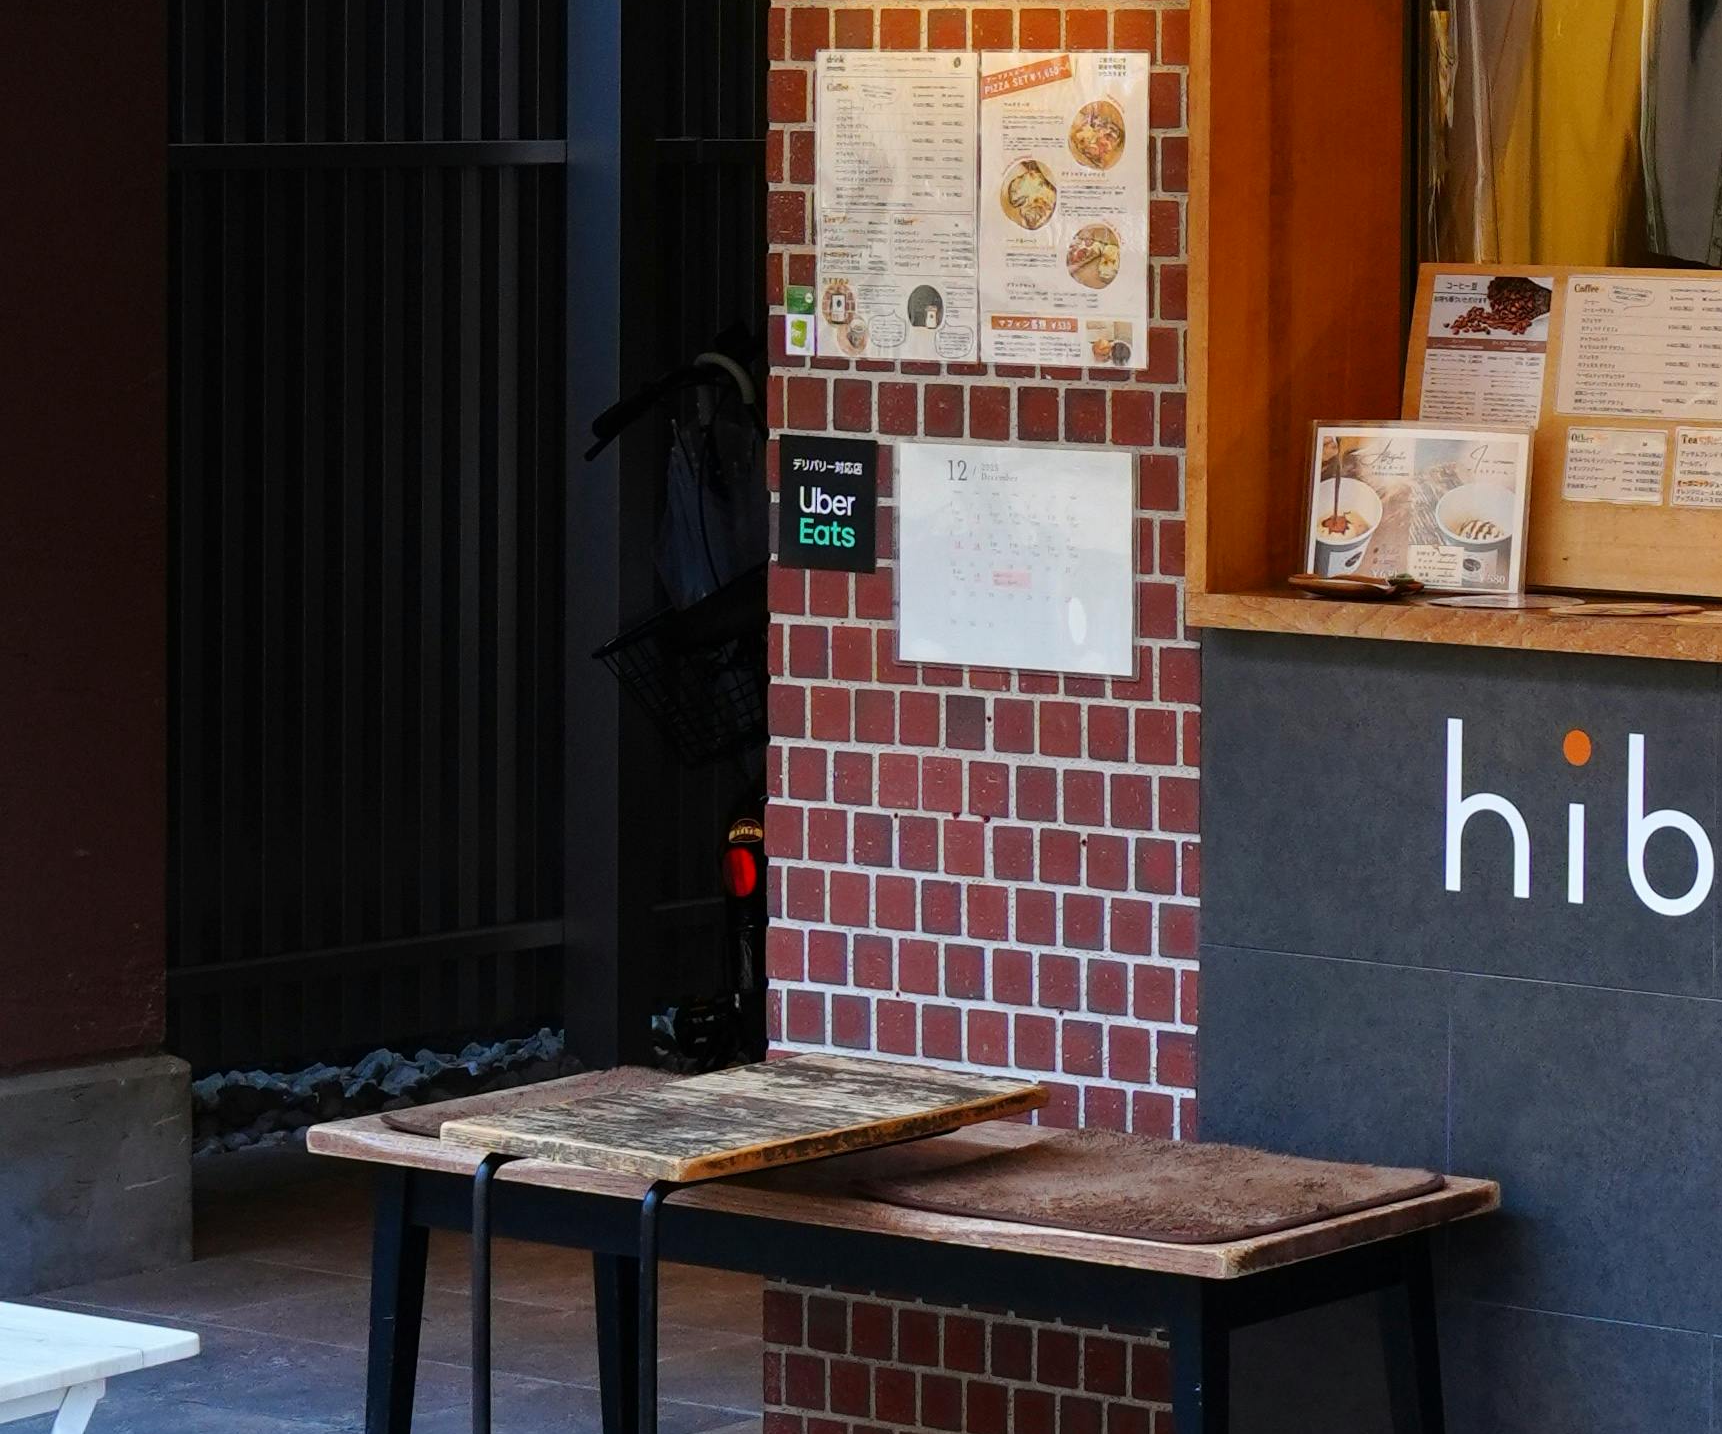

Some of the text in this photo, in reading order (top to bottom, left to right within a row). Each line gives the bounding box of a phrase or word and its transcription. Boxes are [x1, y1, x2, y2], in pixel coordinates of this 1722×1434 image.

[1012, 75, 1029, 87] SET
[1446, 281, 1478, 291] コーヒー豆
[1574, 283, 1600, 293] Coffee
[1681, 433, 1698, 444] Tea
[793, 458, 863, 475] デリバリー対応店
[947, 459, 968, 481] 12
[799, 485, 857, 517] Uber
[799, 517, 856, 548] Eats
